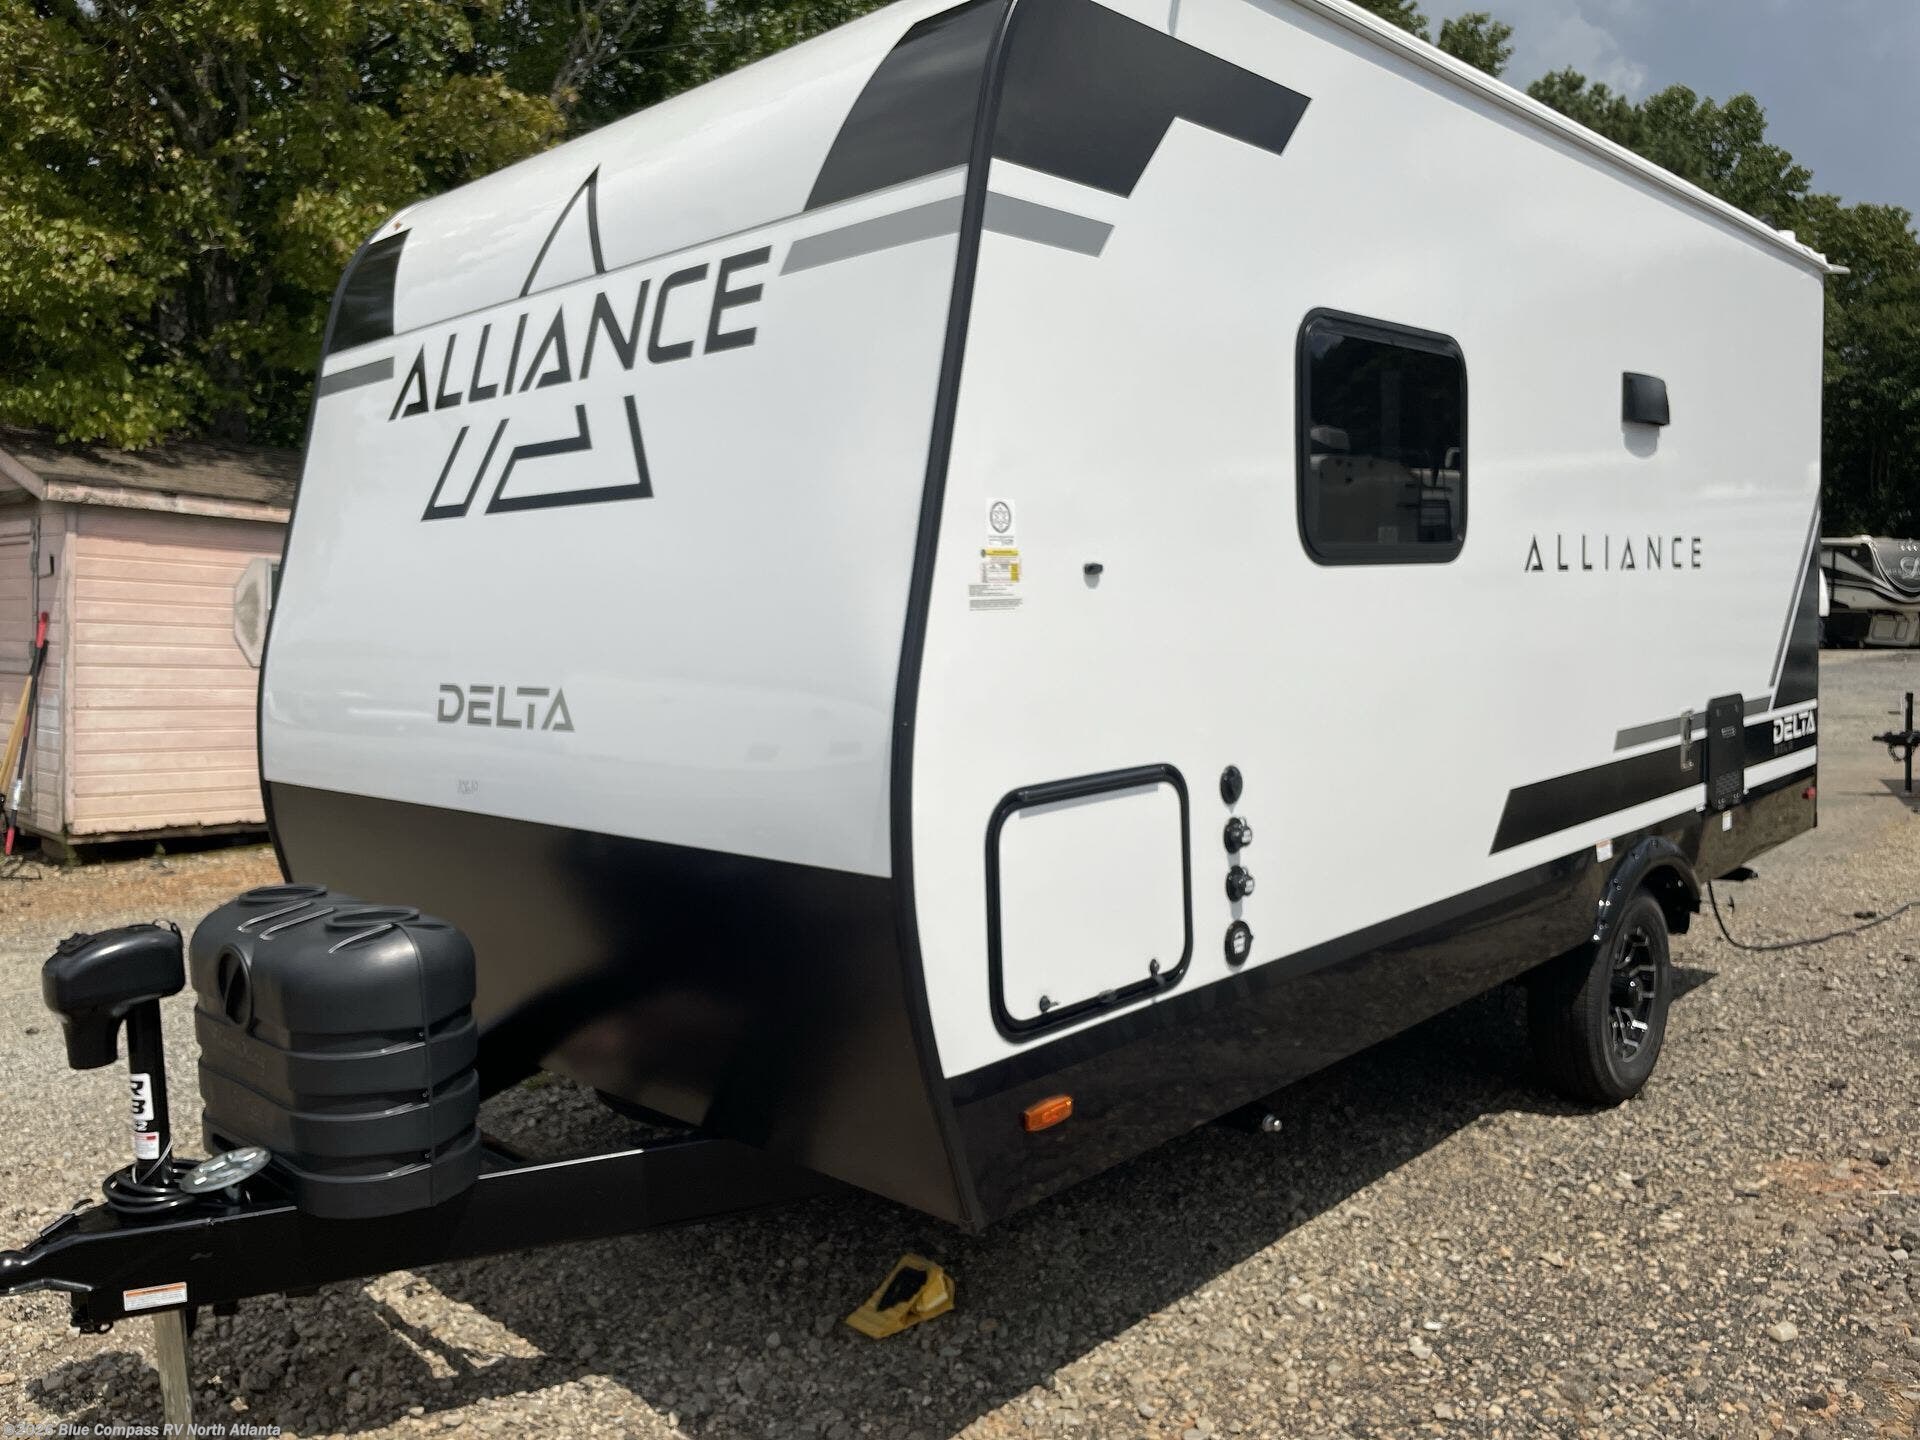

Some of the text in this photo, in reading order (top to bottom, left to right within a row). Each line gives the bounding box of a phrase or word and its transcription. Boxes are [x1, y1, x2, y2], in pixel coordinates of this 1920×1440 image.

[388, 245, 773, 422] ALLIANCE
[1524, 534, 1701, 572] ALLIANCE
[438, 684, 575, 731] DELTA
[1773, 710, 1816, 744] DELTA
